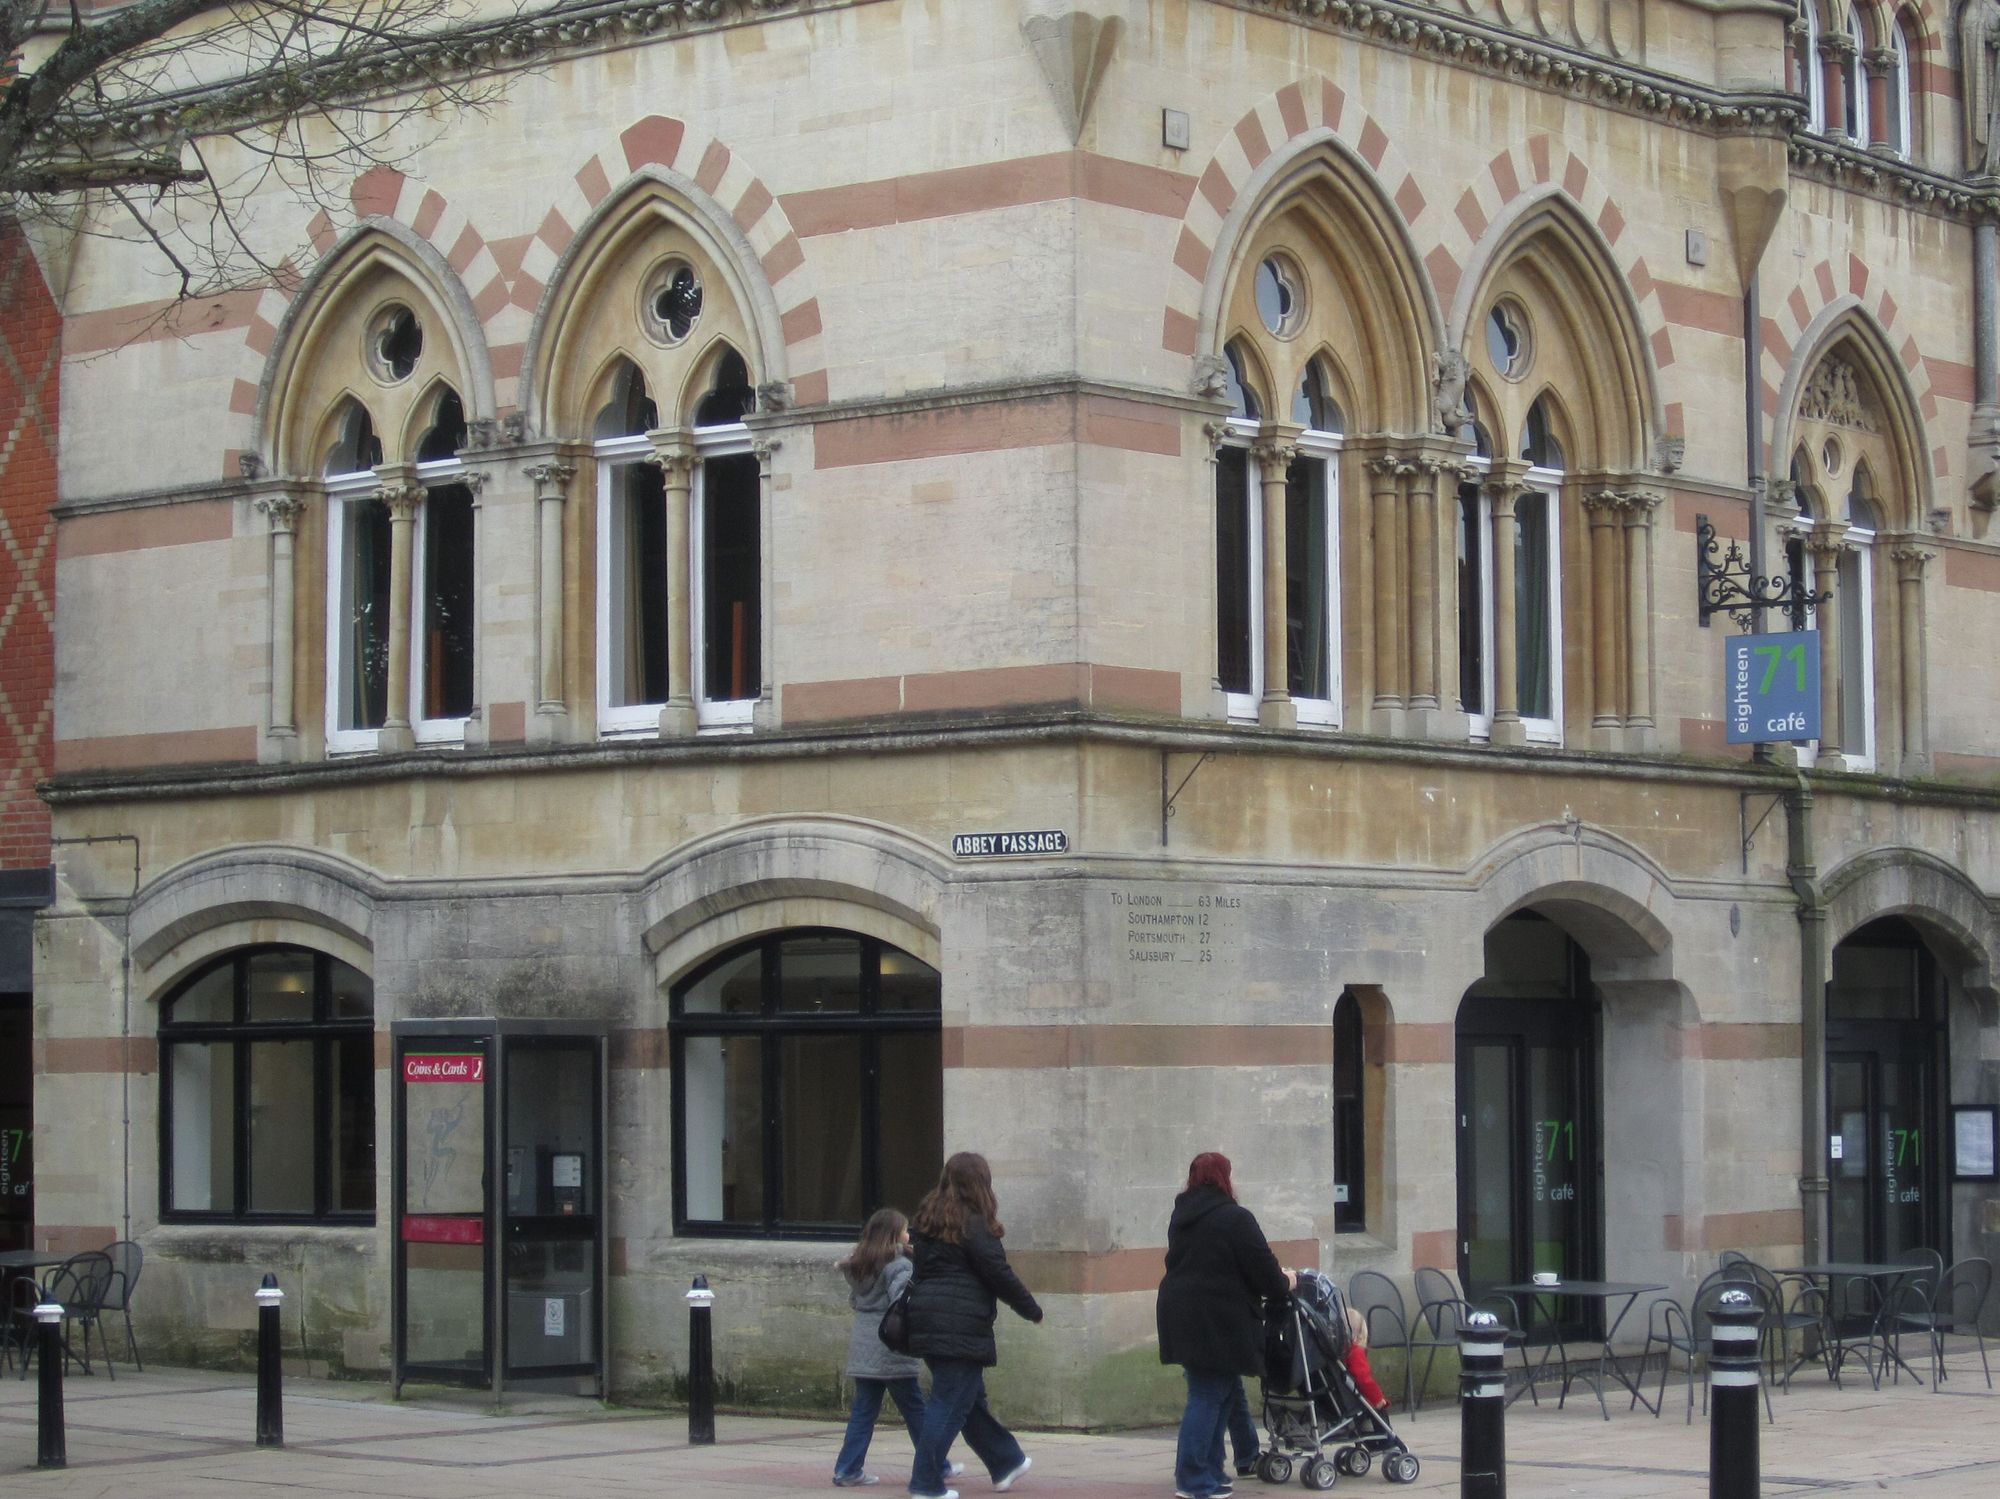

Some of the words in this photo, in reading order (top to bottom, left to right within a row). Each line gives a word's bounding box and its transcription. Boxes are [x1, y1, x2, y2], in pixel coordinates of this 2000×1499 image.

[1754, 644, 1806, 695] 71
[1734, 647, 1752, 733] eighteen
[1767, 712, 1806, 732] café
[956, 836, 997, 854] ABBEY
[1001, 833, 1063, 852] PASSAGE
[1127, 892, 1162, 906] LONDON
[1198, 895, 1211, 907] 63
[1215, 896, 1241, 908] MILES
[1128, 911, 1194, 926] SOUTHAMPTON
[1198, 913, 1209, 926] 12
[1128, 930, 1185, 943] PORTSMOUTH
[1200, 931, 1211, 944] 27
[1129, 948, 1175, 961] SALISBURY
[407, 1060, 432, 1075] Coins
[432, 1062, 440, 1075] &
[441, 1061, 468, 1075] Cards
[1544, 1120, 1574, 1161] 71
[1894, 1128, 1921, 1167] 71
[1533, 1121, 1546, 1201] eighteen
[1886, 1130, 1897, 1204] eighteen
[1551, 1183, 1574, 1200] café
[1900, 1186, 1920, 1202] café
